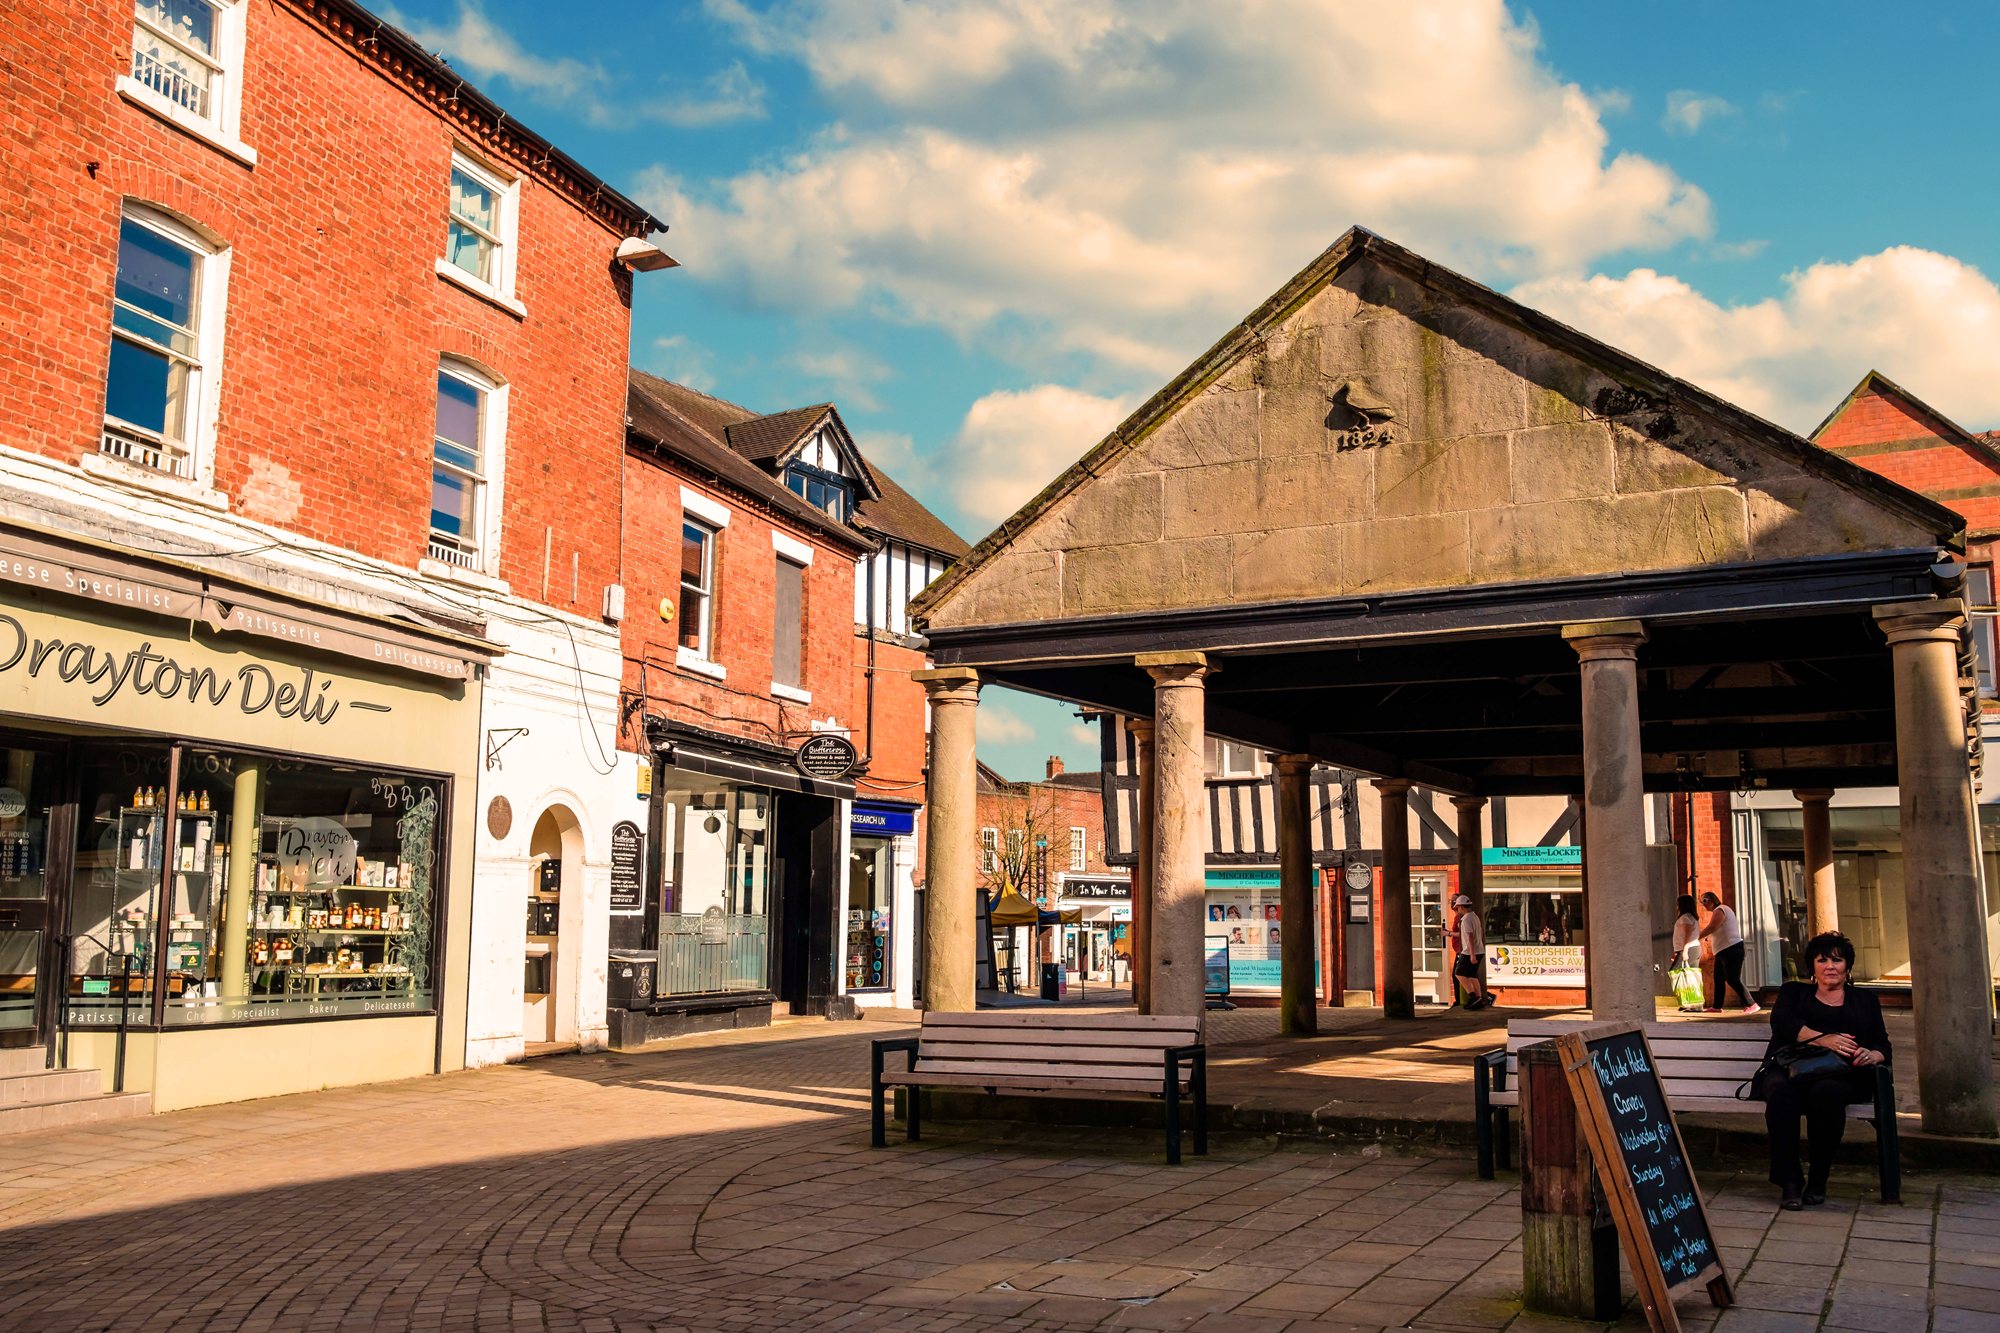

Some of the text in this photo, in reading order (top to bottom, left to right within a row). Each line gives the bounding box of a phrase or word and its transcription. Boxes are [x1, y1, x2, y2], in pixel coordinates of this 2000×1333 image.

[1338, 430, 1394, 451] 1824
[65, 571, 170, 608] Specialist
[236, 611, 321, 643] Patisserie
[374, 642, 464, 675] Delicatessen
[238, 663, 339, 725] Deli
[820, 739, 835, 747] The
[850, 814, 886, 825] RESEARCH UK
[9, 831, 30, 839] HOURS
[1080, 884, 1127, 896] In Your Face
[1511, 948, 1578, 956] SHROPSHIRE
[1512, 957, 1584, 966] BUSINESS AW
[1513, 966, 1539, 975] 2017
[309, 1004, 340, 1014] Bakery
[364, 1001, 416, 1011] Delicatessen
[69, 1011, 145, 1022] Patissie
[231, 1007, 281, 1020] Specialist
[1593, 1046, 1651, 1087] The Tudor Hotel
[1631, 1163, 1666, 1187] Sunday
[1647, 1207, 1660, 1229] All
